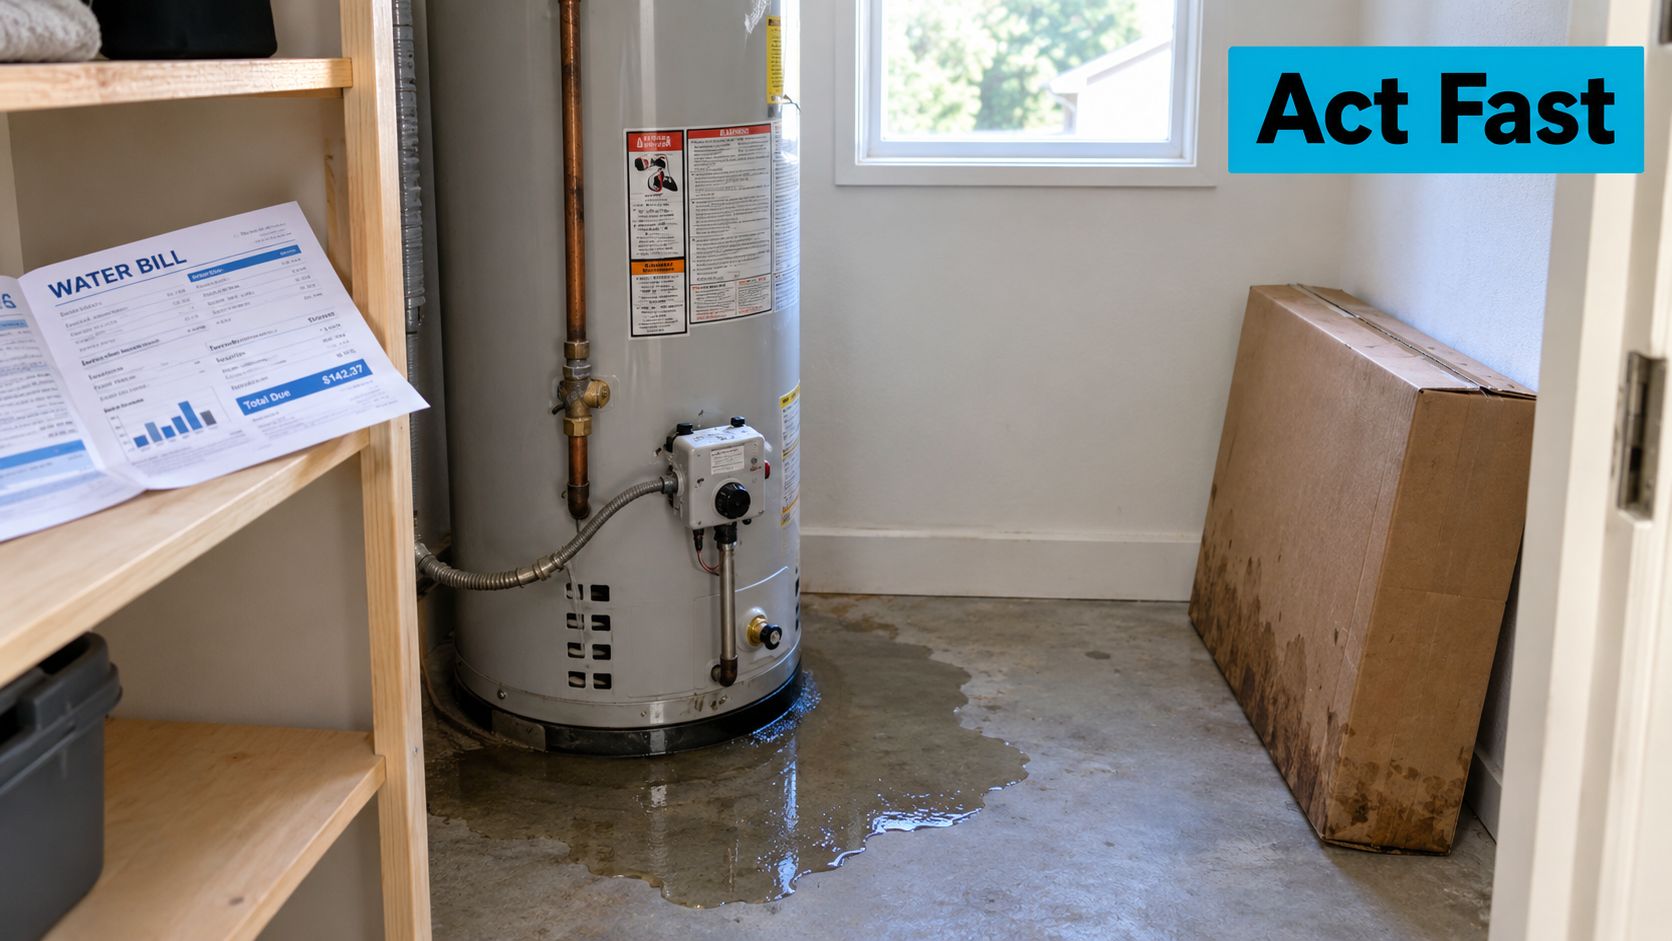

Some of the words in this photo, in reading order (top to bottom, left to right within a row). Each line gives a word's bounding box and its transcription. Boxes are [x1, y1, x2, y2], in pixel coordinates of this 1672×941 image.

[48, 263, 133, 298] WATER
[135, 250, 187, 274] BILL
[243, 395, 269, 410] Total
[270, 389, 291, 402] Due
[322, 364, 363, 385] $142.37
